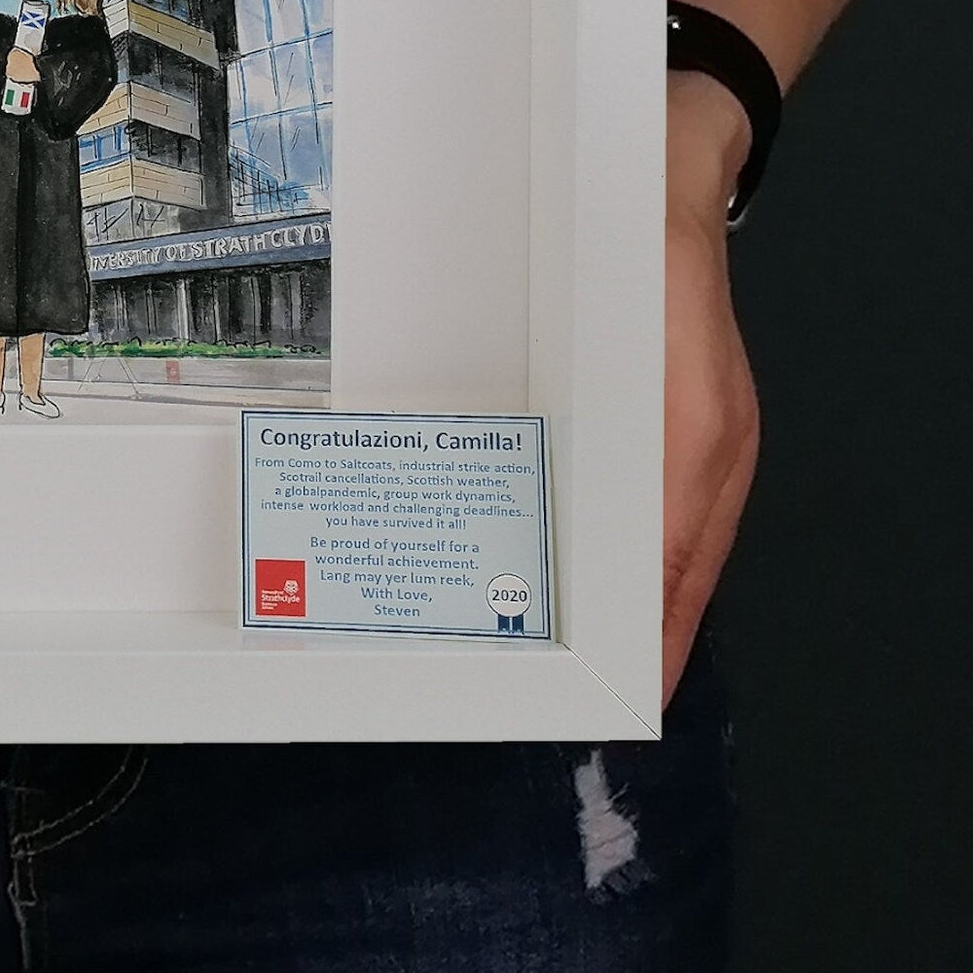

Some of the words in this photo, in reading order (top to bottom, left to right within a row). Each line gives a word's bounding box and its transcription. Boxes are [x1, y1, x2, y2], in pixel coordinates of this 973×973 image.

[260, 427, 429, 453] Congratulazioni,
[435, 431, 522, 451] Camilla!
[254, 457, 285, 468] From
[288, 457, 322, 469] Como
[325, 458, 337, 469] to
[340, 458, 397, 472] Saltcoats,
[399, 459, 455, 472] industrial
[458, 461, 491, 473] strike
[494, 463, 536, 476] action,
[279, 472, 322, 483] Scotrail
[325, 473, 404, 486] cancellations,
[407, 474, 453, 486] Scottish
[456, 477, 510, 489] weather,
[275, 487, 282, 496] a
[383, 490, 418, 501] group
[421, 489, 452, 500] work
[455, 490, 516, 504] dynamics,
[260, 499, 305, 511] intense
[309, 501, 364, 513] workload
[367, 502, 389, 513] and
[392, 503, 461, 518] challenging
[463, 505, 535, 518] deadlines...
[325, 517, 348, 528] you
[351, 515, 379, 527] have
[382, 518, 433, 529] survived
[436, 518, 446, 529] it
[448, 519, 467, 530] all!
[310, 536, 327, 548] Be
[330, 536, 370, 552] proud
[374, 538, 389, 550] of
[390, 539, 446, 554] yourself
[448, 540, 470, 553] for
[471, 543, 480, 553] a
[315, 553, 384, 567] wonderful
[387, 556, 479, 570] achievement.
[320, 569, 351, 583] Lang
[354, 573, 382, 587] may
[384, 574, 408, 588] yer
[410, 574, 437, 585] lum
[439, 576, 475, 588] reek,
[360, 587, 394, 600] With
[397, 588, 433, 603] Love,
[491, 589, 528, 603] 2020
[374, 604, 421, 617] Steven
